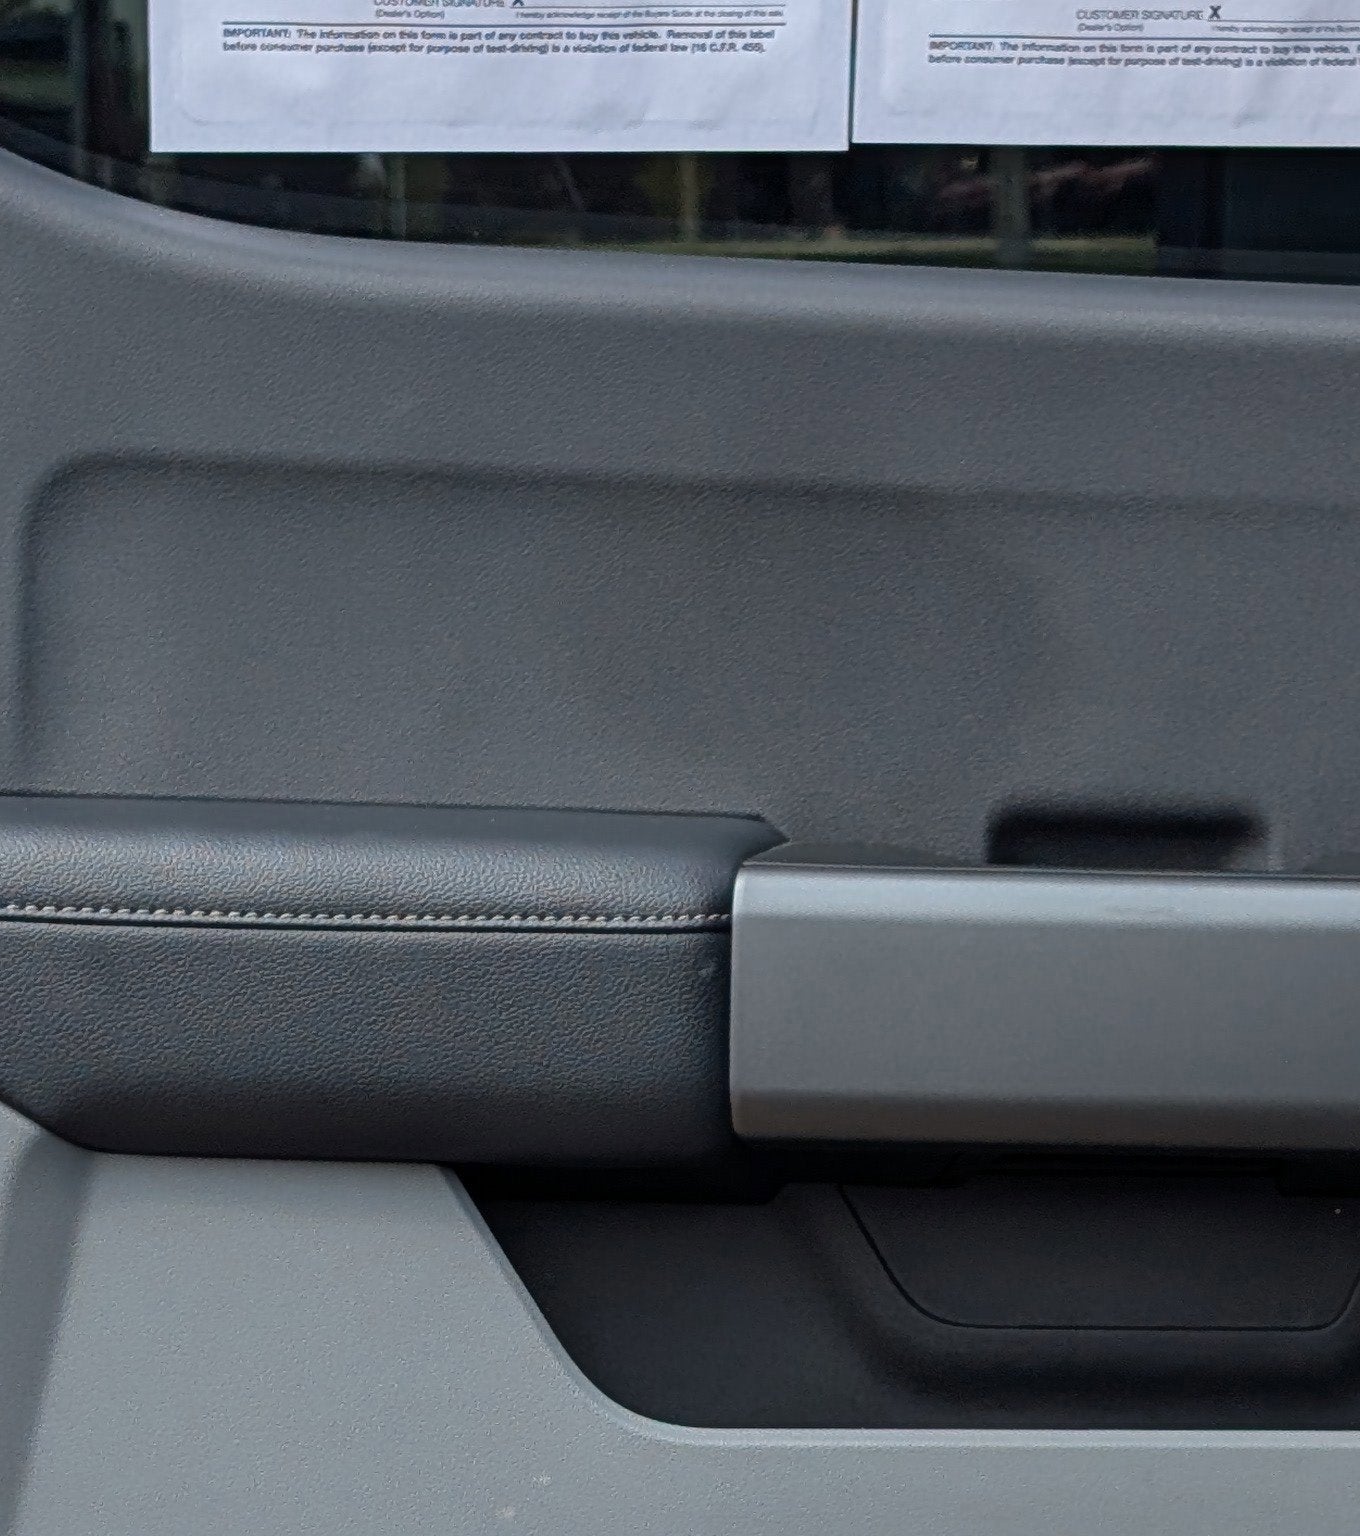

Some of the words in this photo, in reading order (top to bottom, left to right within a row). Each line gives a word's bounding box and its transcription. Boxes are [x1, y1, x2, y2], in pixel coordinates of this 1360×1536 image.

[1209, 6, 1221, 20] X
[296, 29, 316, 38] The
[319, 30, 380, 39] information
[383, 31, 396, 39] on
[400, 30, 418, 39] this
[421, 31, 446, 39] form
[450, 31, 458, 39] is
[460, 31, 482, 41] part
[485, 31, 496, 39] of
[499, 33, 516, 41] any
[520, 32, 563, 40] contract
[566, 31, 577, 40] to
[579, 31, 598, 41] buy
[601, 31, 620, 40] this
[666, 30, 712, 39] Removal
[715, 30, 726, 39] of
[728, 30, 747, 39] this
[750, 30, 775, 38] label
[222, 42, 258, 50] before
[315, 43, 365, 53] purchase
[368, 43, 406, 53] (except
[408, 43, 424, 51] for
[426, 44, 470, 54] purpose
[473, 44, 484, 52] of
[486, 44, 549, 54] test-driving)
[552, 44, 560, 52] is
[572, 44, 617, 52] violation
[619, 44, 629, 52] of
[632, 43, 668, 52] federal
[670, 43, 688, 51] law
[1000, 42, 1018, 50] The
[1022, 43, 1080, 52] information
[1099, 44, 1117, 52] this
[1120, 44, 1143, 52] form
[1156, 45, 1178, 54] part
[1194, 46, 1212, 54] any
[1260, 46, 1270, 54] to
[1272, 46, 1290, 55] buy
[1293, 46, 1311, 54] this
[928, 55, 962, 63] before
[1017, 56, 1064, 65] purchase
[1068, 56, 1105, 66] (except
[1108, 56, 1122, 65] for
[1124, 58, 1166, 67] purpose
[1169, 57, 1179, 65] of
[1182, 57, 1242, 68] test-driving)
[1245, 58, 1254, 66] is
[1266, 58, 1306, 66] violation
[1310, 58, 1320, 66] of
[1322, 57, 1356, 66] federal
